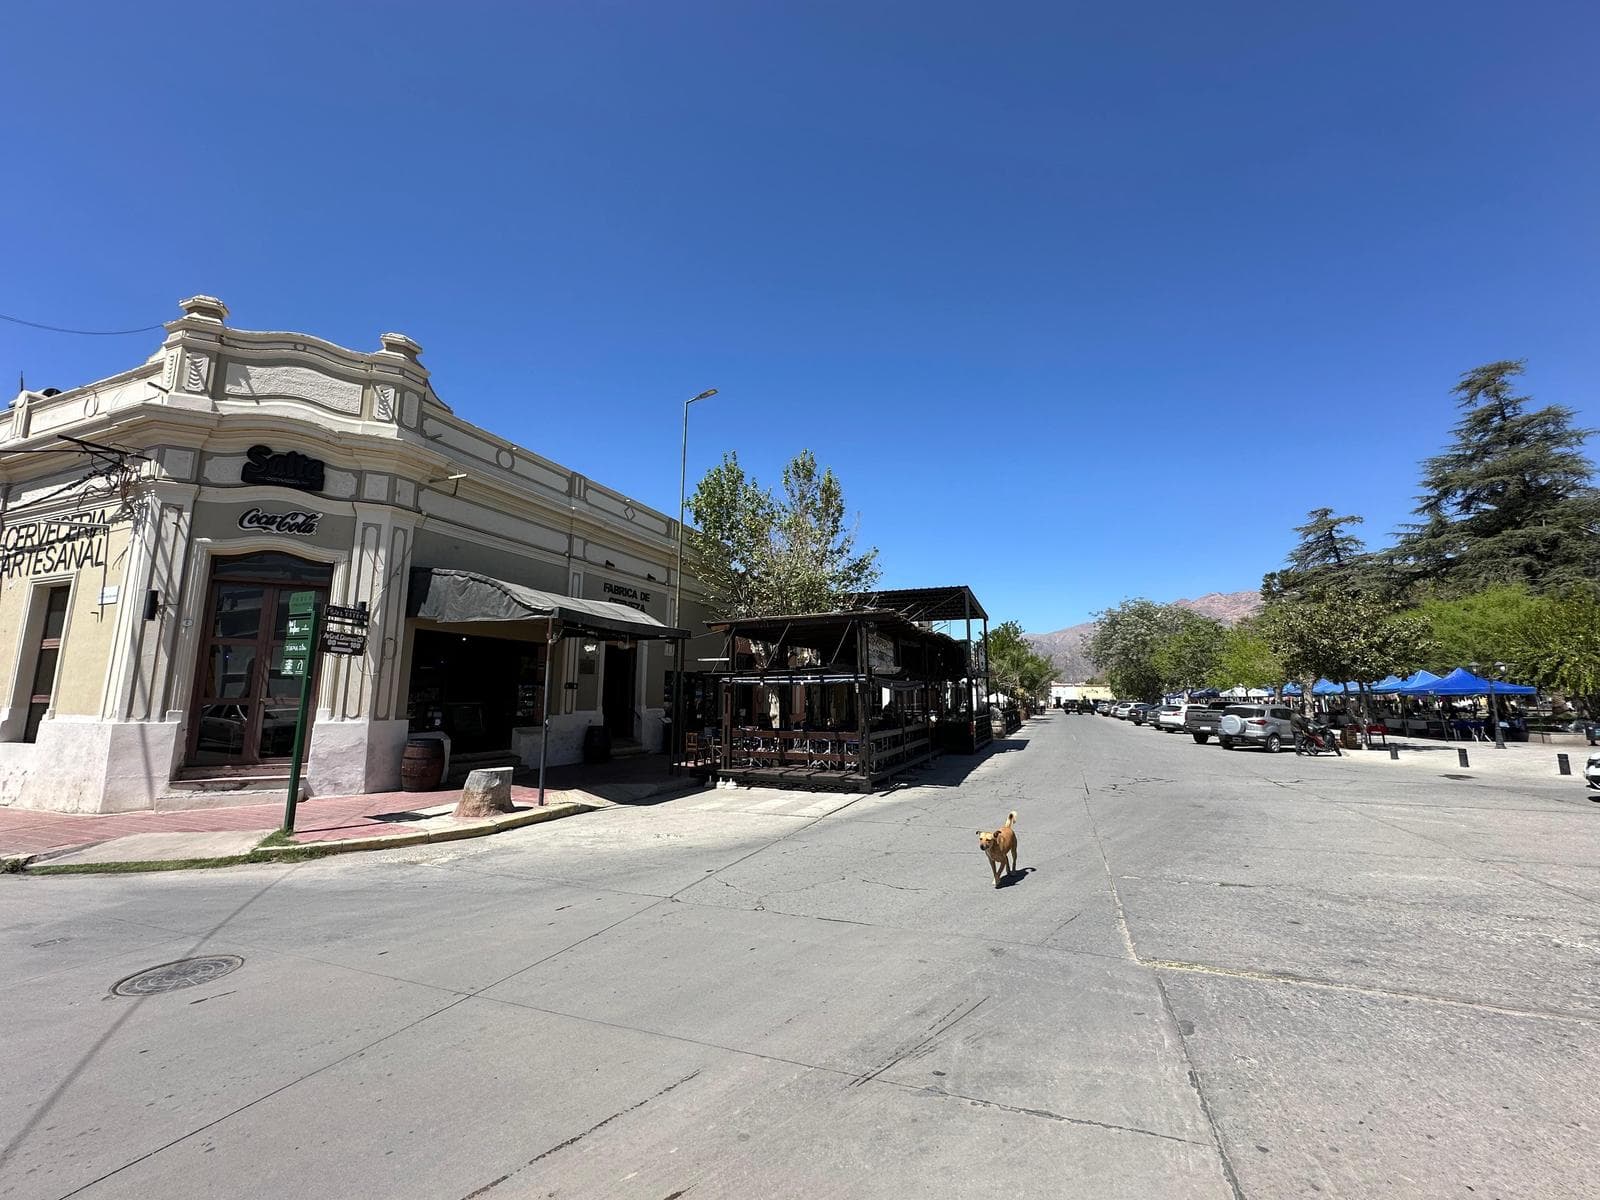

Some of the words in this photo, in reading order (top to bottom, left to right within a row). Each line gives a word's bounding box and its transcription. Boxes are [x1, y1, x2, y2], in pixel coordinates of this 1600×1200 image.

[239, 508, 319, 533] Coca-Cola
[0, 538, 105, 579] ARTESANAL
[603, 582, 638, 599] FABRICA
[640, 592, 651, 602] DE
